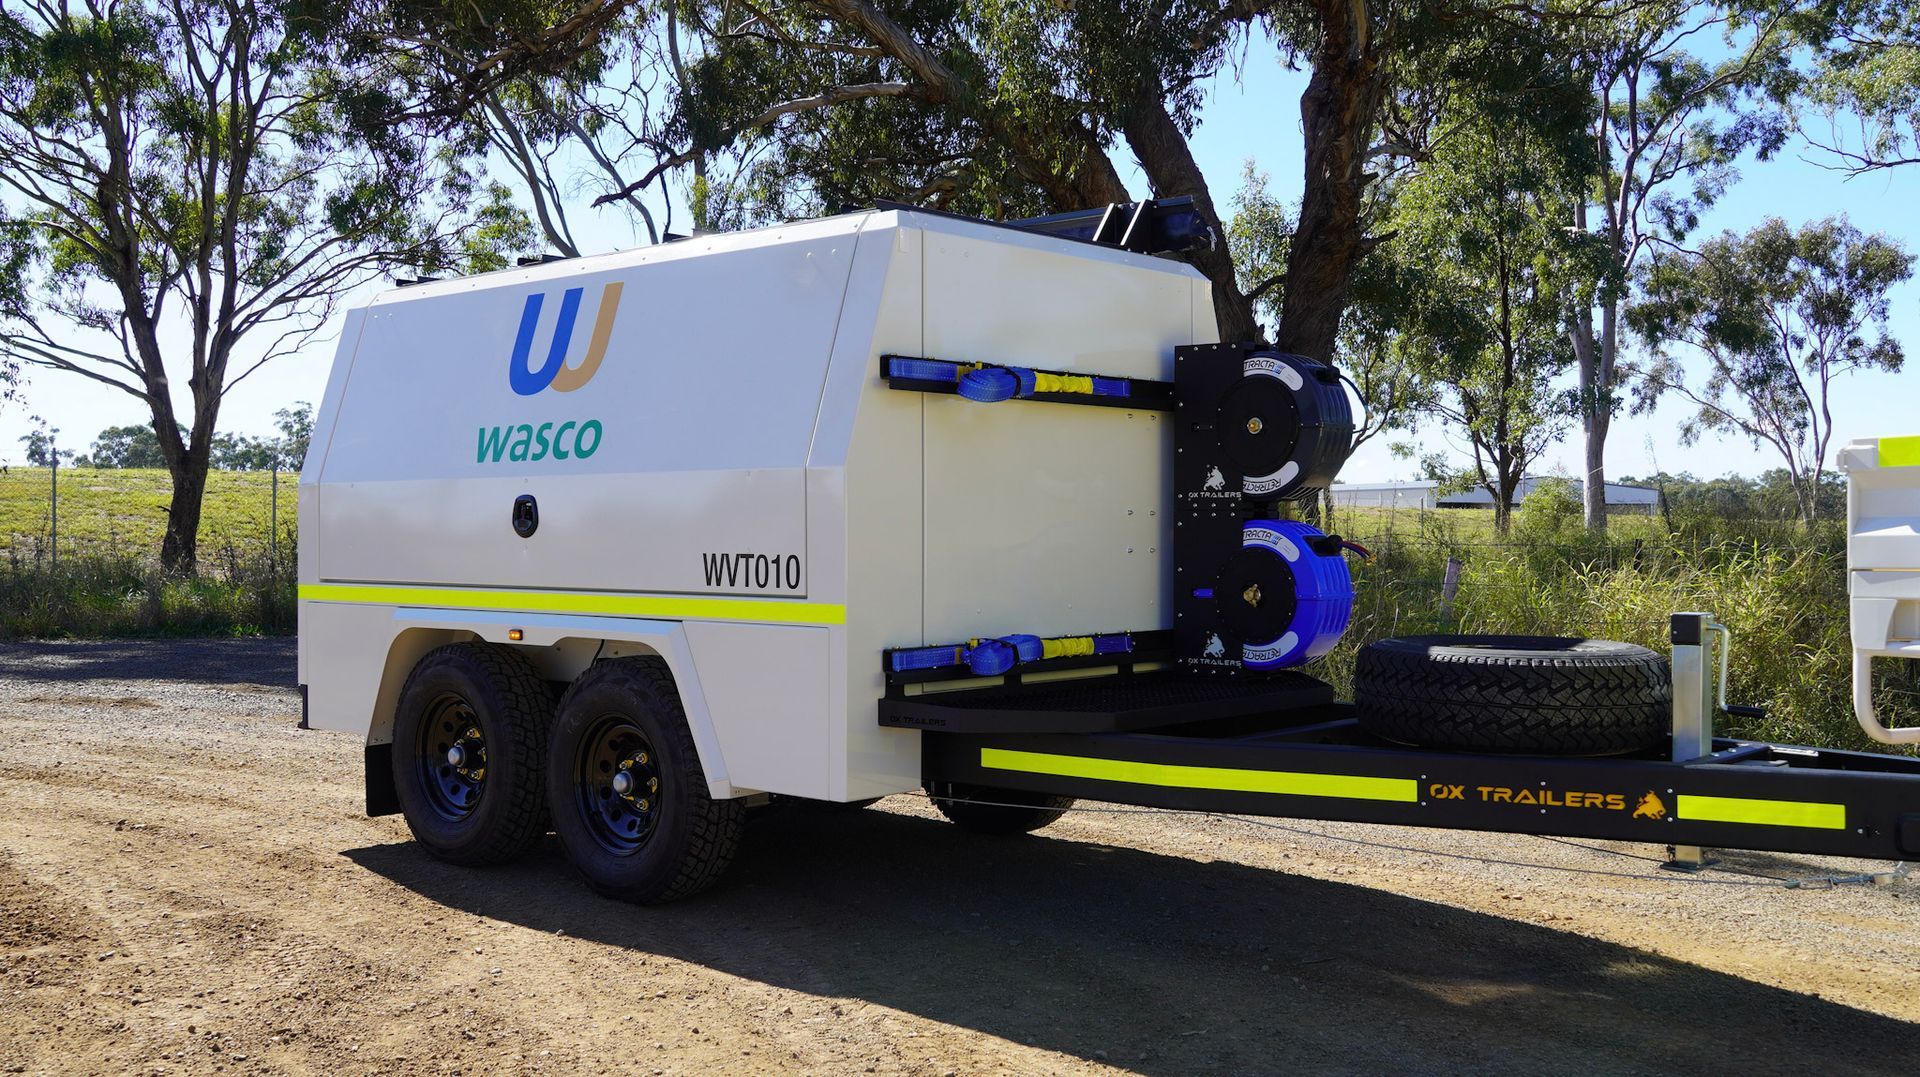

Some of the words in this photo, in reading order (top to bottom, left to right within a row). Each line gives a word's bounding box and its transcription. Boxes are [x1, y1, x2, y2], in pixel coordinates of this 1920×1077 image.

[1244, 359, 1276, 370] TRACTA
[476, 418, 603, 464] wasco
[1243, 529, 1272, 540] TRACTA
[703, 553, 801, 590] WVT010
[1200, 658, 1242, 667] TRAILERS
[1430, 783, 1465, 800] OX
[1477, 786, 1626, 811] TRAILERS
